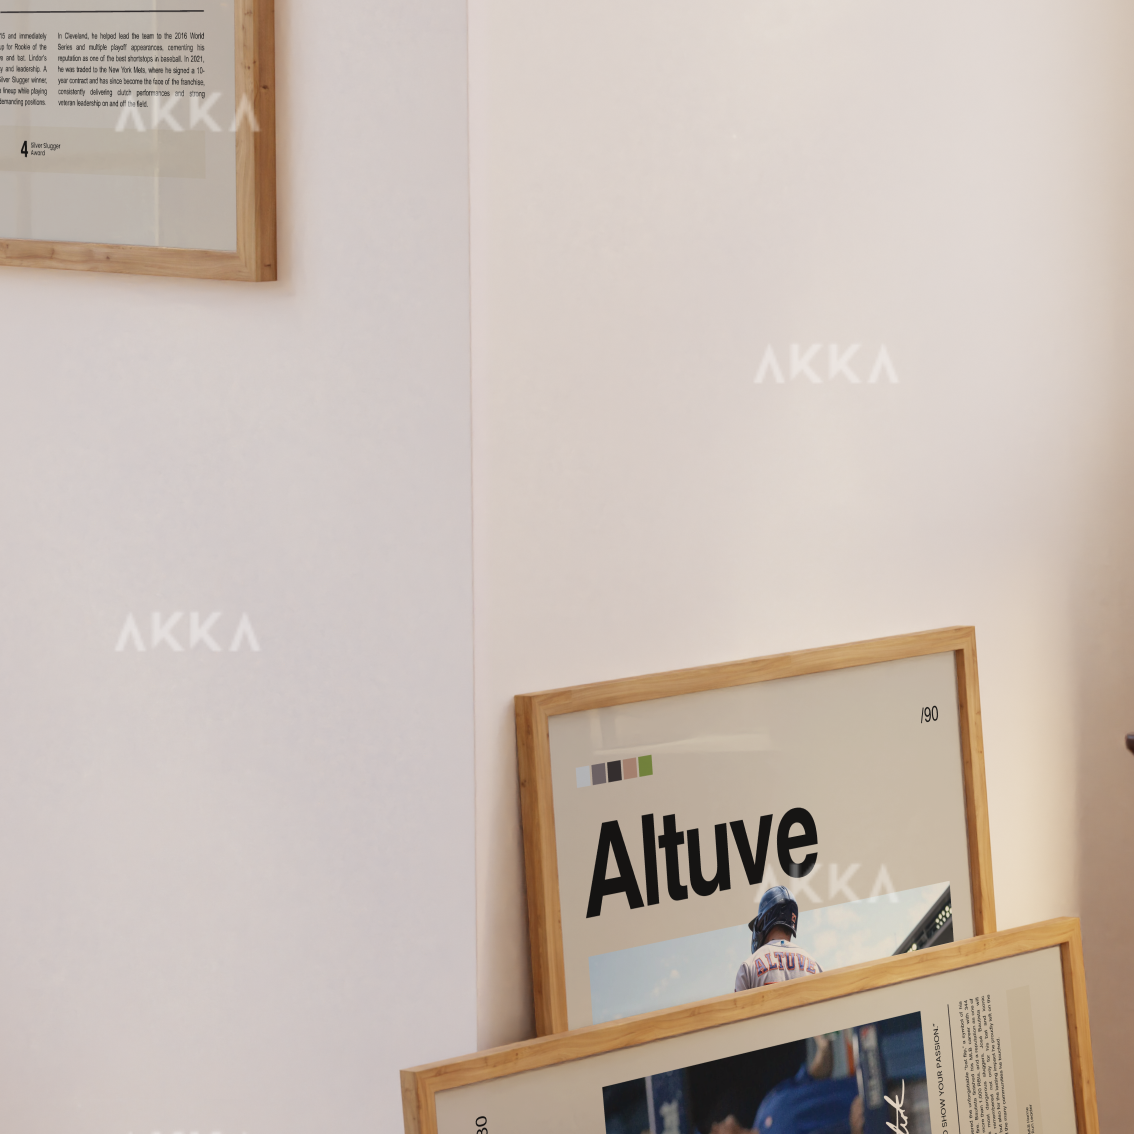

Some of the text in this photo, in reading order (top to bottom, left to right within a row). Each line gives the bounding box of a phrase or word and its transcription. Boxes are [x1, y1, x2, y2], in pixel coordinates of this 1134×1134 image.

[100, 33, 117, 41] helped
[88, 44, 108, 52] multiple
[110, 44, 127, 52] playoff
[168, 44, 194, 53] cementing
[58, 55, 82, 63] reputation
[128, 55, 154, 64] shortstops
[58, 88, 86, 97] consistently
[90, 89, 113, 97] delivering
[76, 100, 101, 108] leadership
[21, 141, 28, 157] 4
[920, 704, 939, 724] /90
[586, 807, 818, 918] Altuve
[754, 952, 816, 976] ALTUVE
[940, 1099, 948, 1131] SHOW
